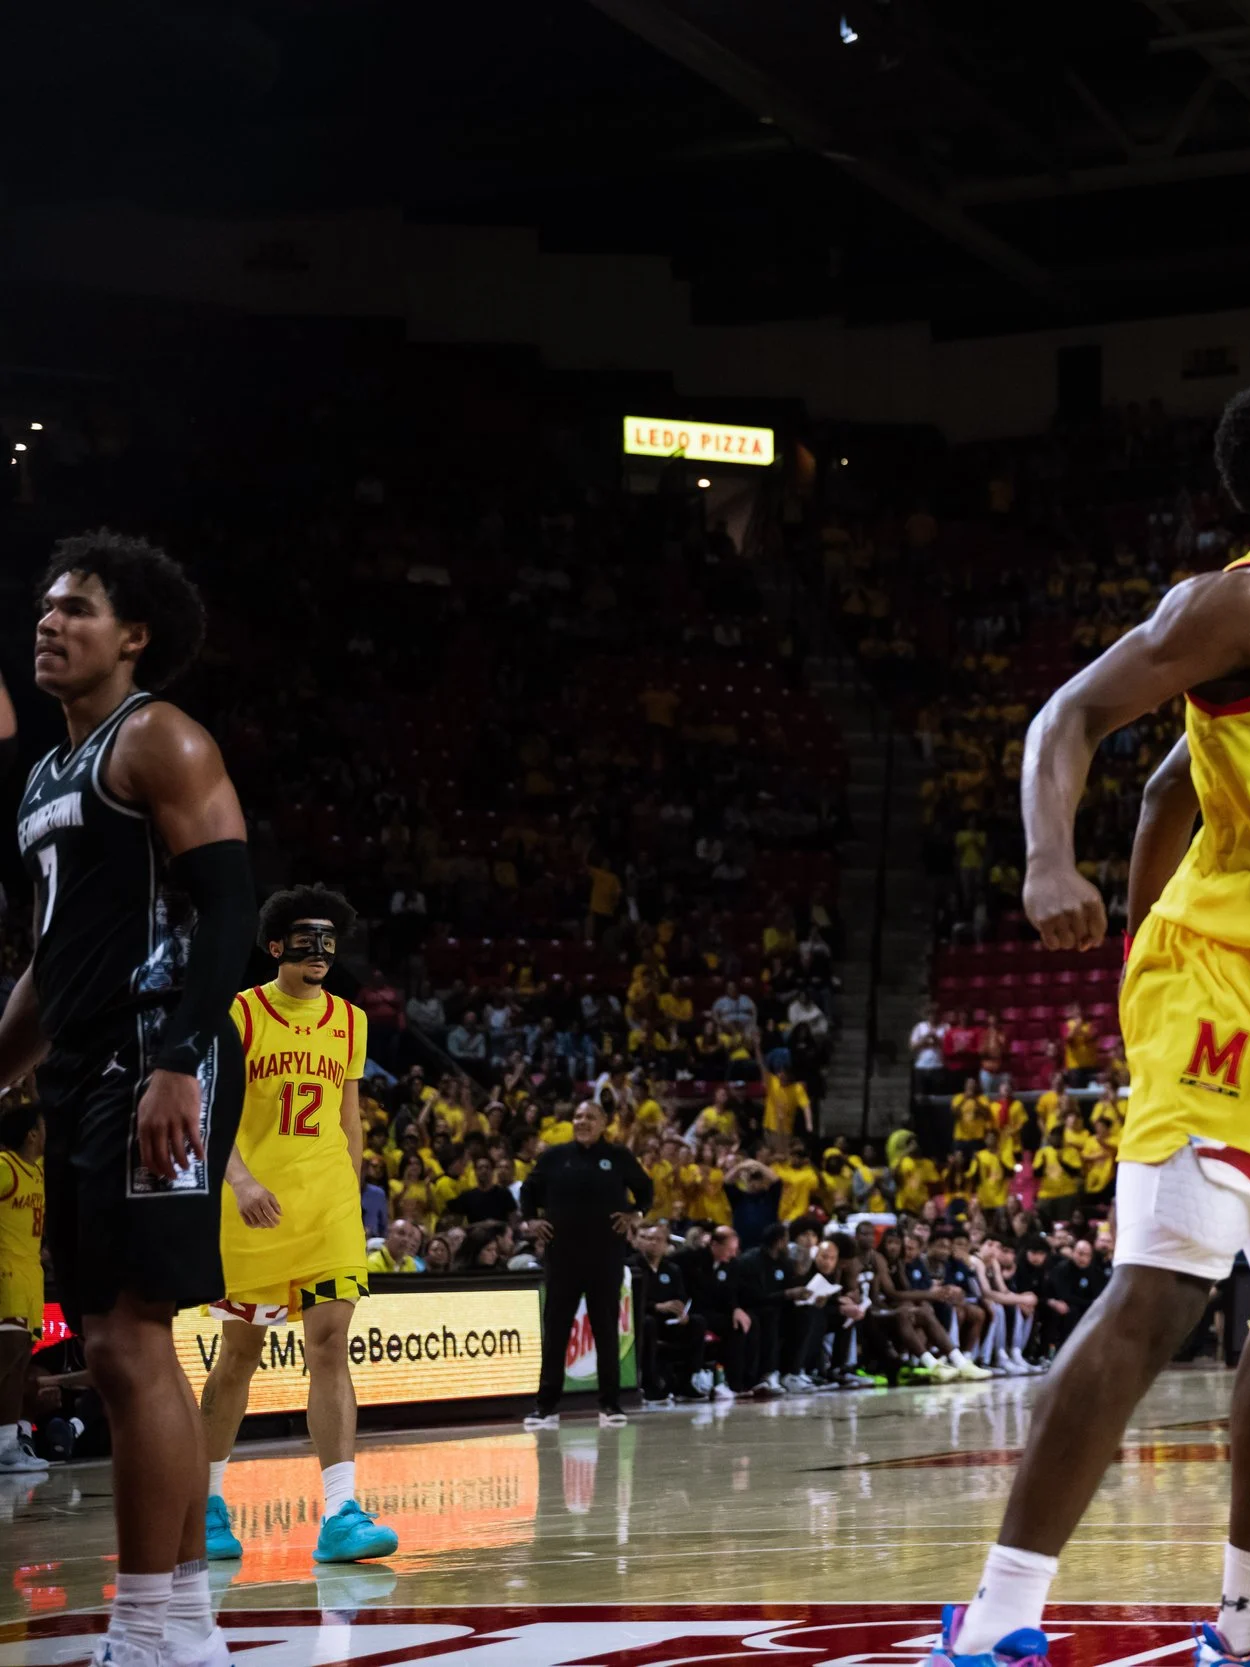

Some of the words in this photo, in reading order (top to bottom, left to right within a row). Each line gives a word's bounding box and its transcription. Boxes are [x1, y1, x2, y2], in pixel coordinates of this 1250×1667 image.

[635, 428, 690, 449] LEDO
[701, 433, 762, 455] PIZZA
[248, 1051, 345, 1089] MARYLAND
[279, 1081, 323, 1137] 12
